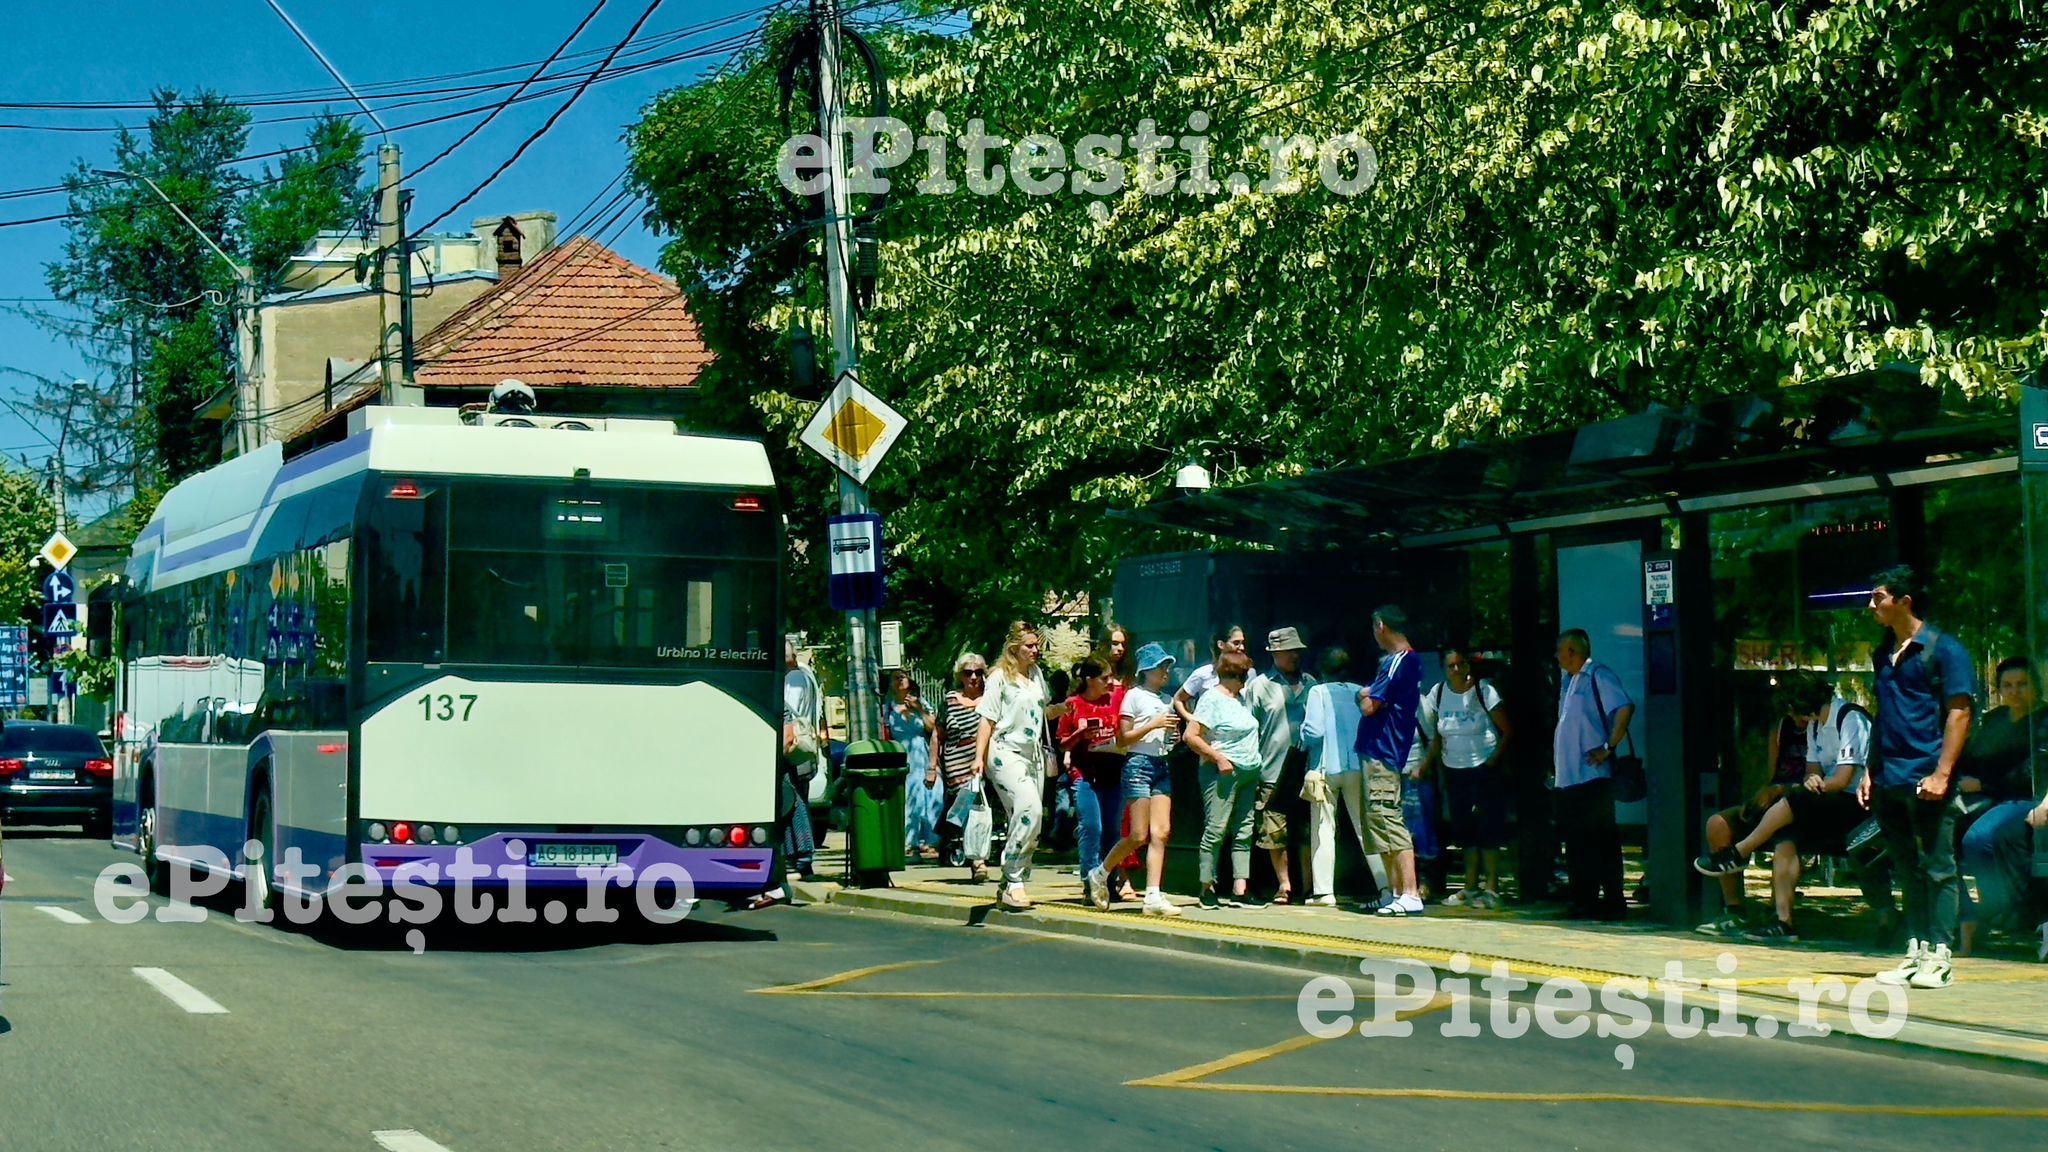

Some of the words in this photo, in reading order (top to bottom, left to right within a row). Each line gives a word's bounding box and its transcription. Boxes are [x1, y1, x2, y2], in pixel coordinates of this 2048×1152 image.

[657, 646, 701, 658] Urbino
[704, 648, 717, 659] 12
[720, 649, 769, 660] electric
[418, 694, 478, 721] 137
[538, 846, 557, 861] AG
[564, 846, 577, 861] 18
[581, 846, 614, 861] PPV
